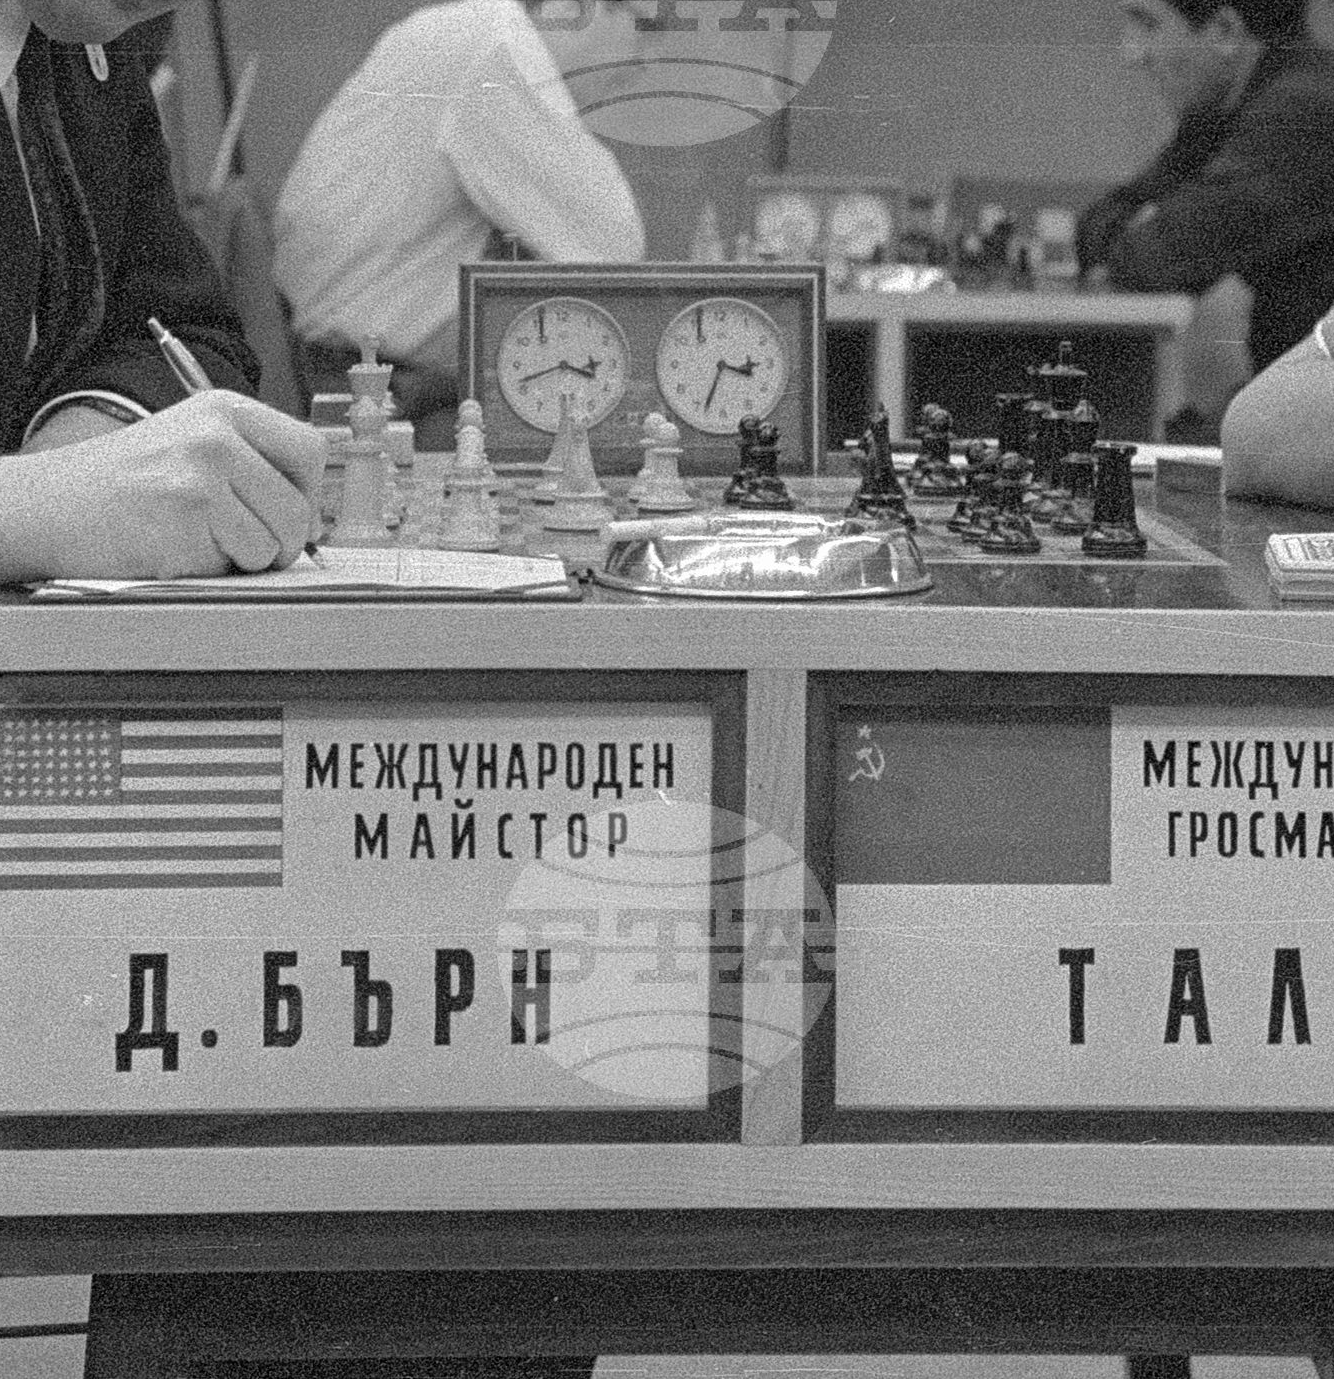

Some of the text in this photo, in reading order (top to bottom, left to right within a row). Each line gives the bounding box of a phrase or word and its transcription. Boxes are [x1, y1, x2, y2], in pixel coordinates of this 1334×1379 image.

[306, 741, 675, 800] МЕЖДУНАРОДЕН
[353, 798, 628, 859] МАЙСТОР
[115, 948, 552, 1072] Д. БЪРН
[1059, 948, 1312, 1045] ТАЛ
